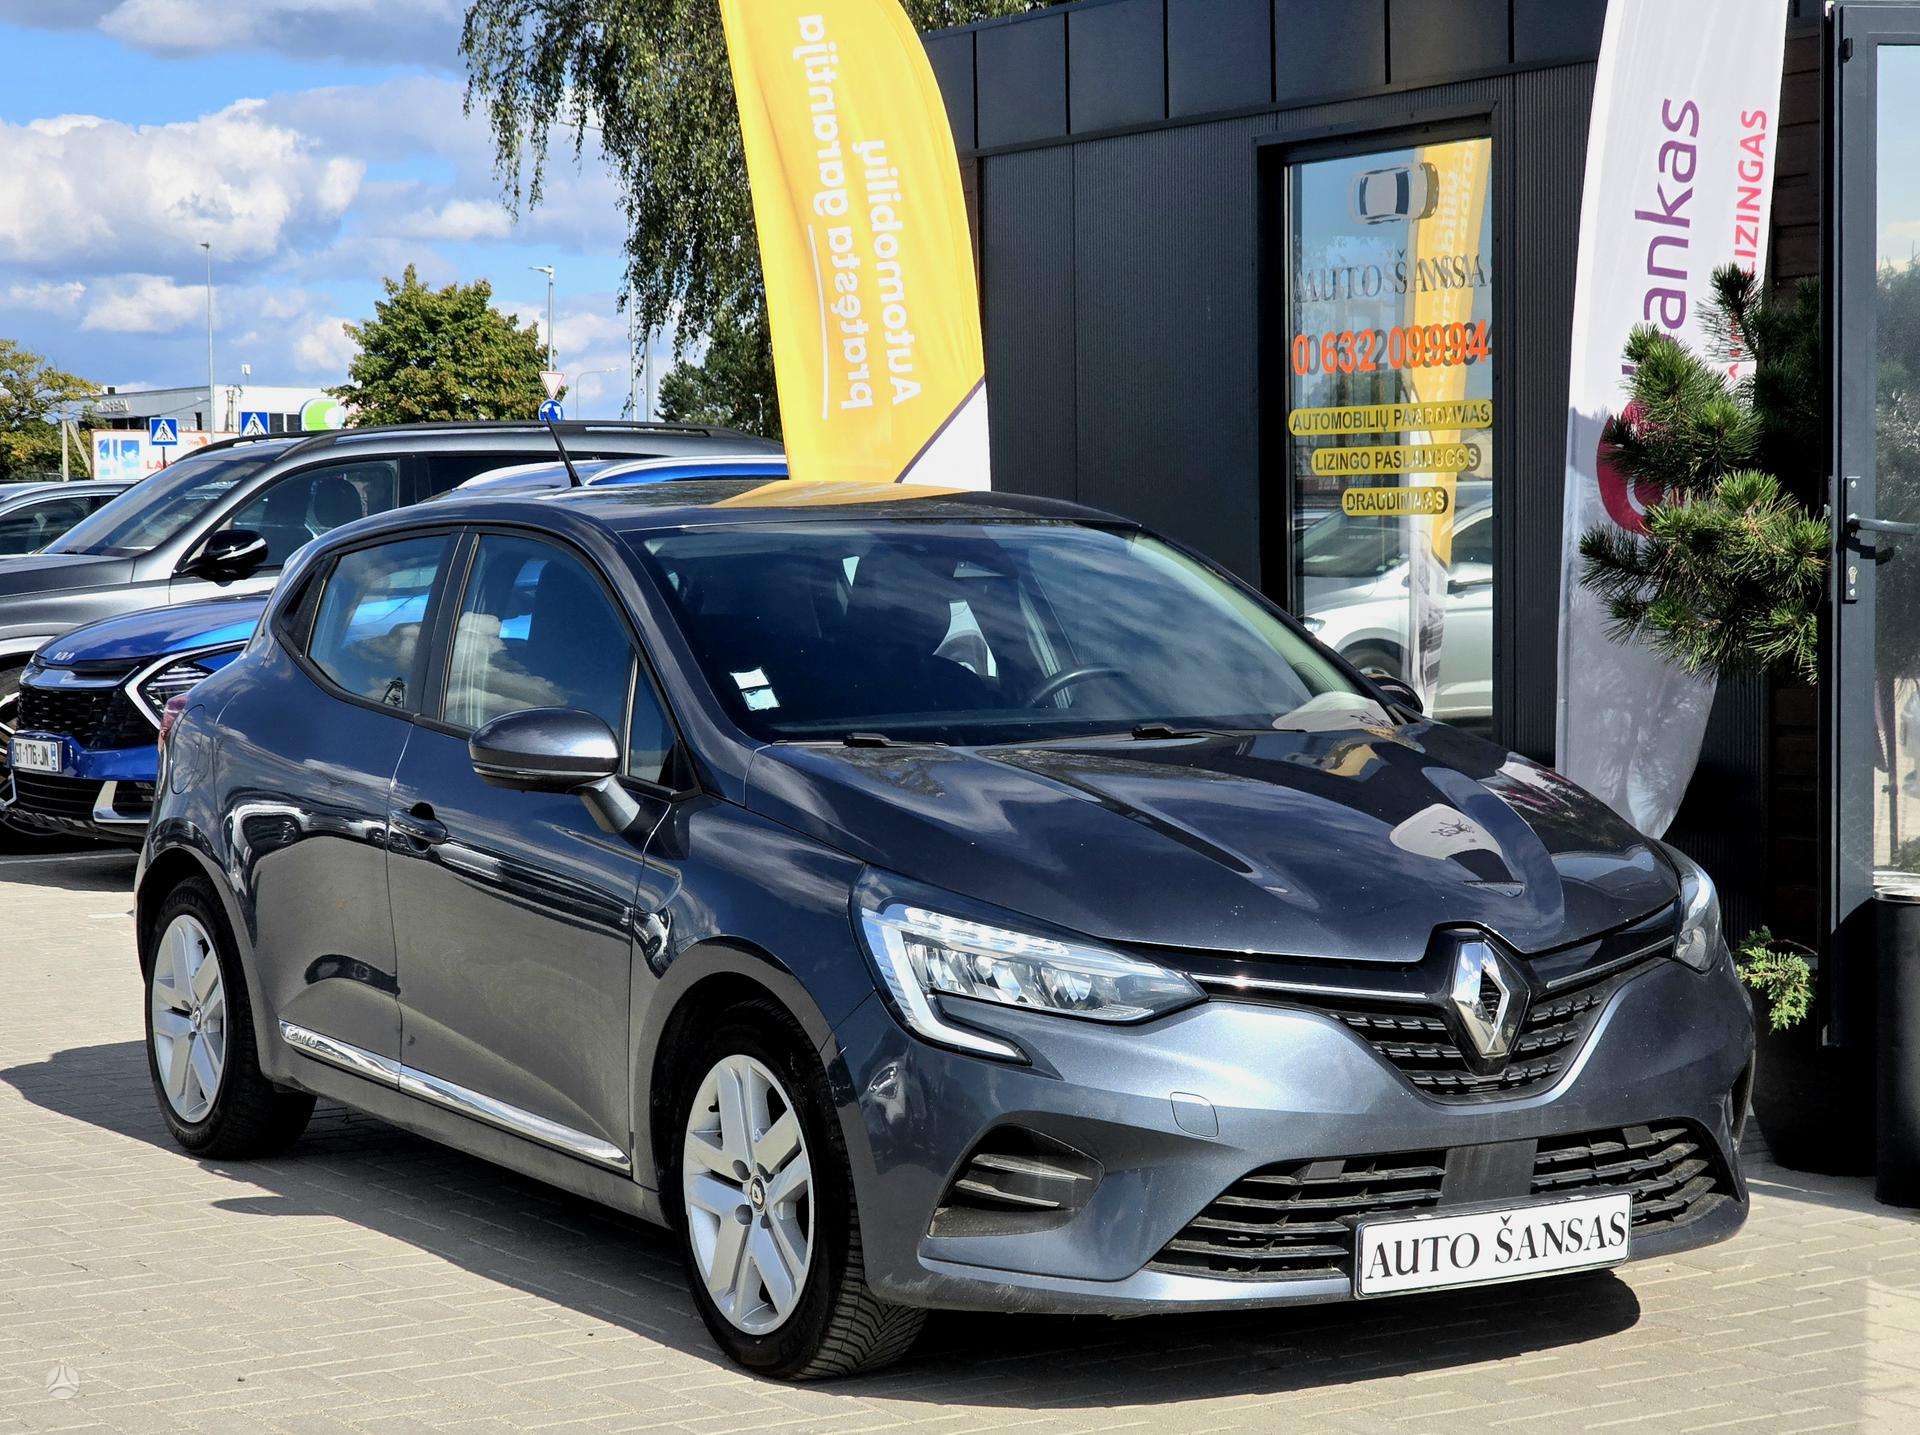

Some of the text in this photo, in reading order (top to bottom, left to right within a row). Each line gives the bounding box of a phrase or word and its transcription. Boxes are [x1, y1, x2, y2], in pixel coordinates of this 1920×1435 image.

[1620, 98, 1700, 377] ankas
[1293, 408, 1389, 433] AUTOMOBILIŲ
[1315, 450, 1371, 471] LIZINGO
[1364, 1211, 1626, 1279] AUTO ŠANSAS
